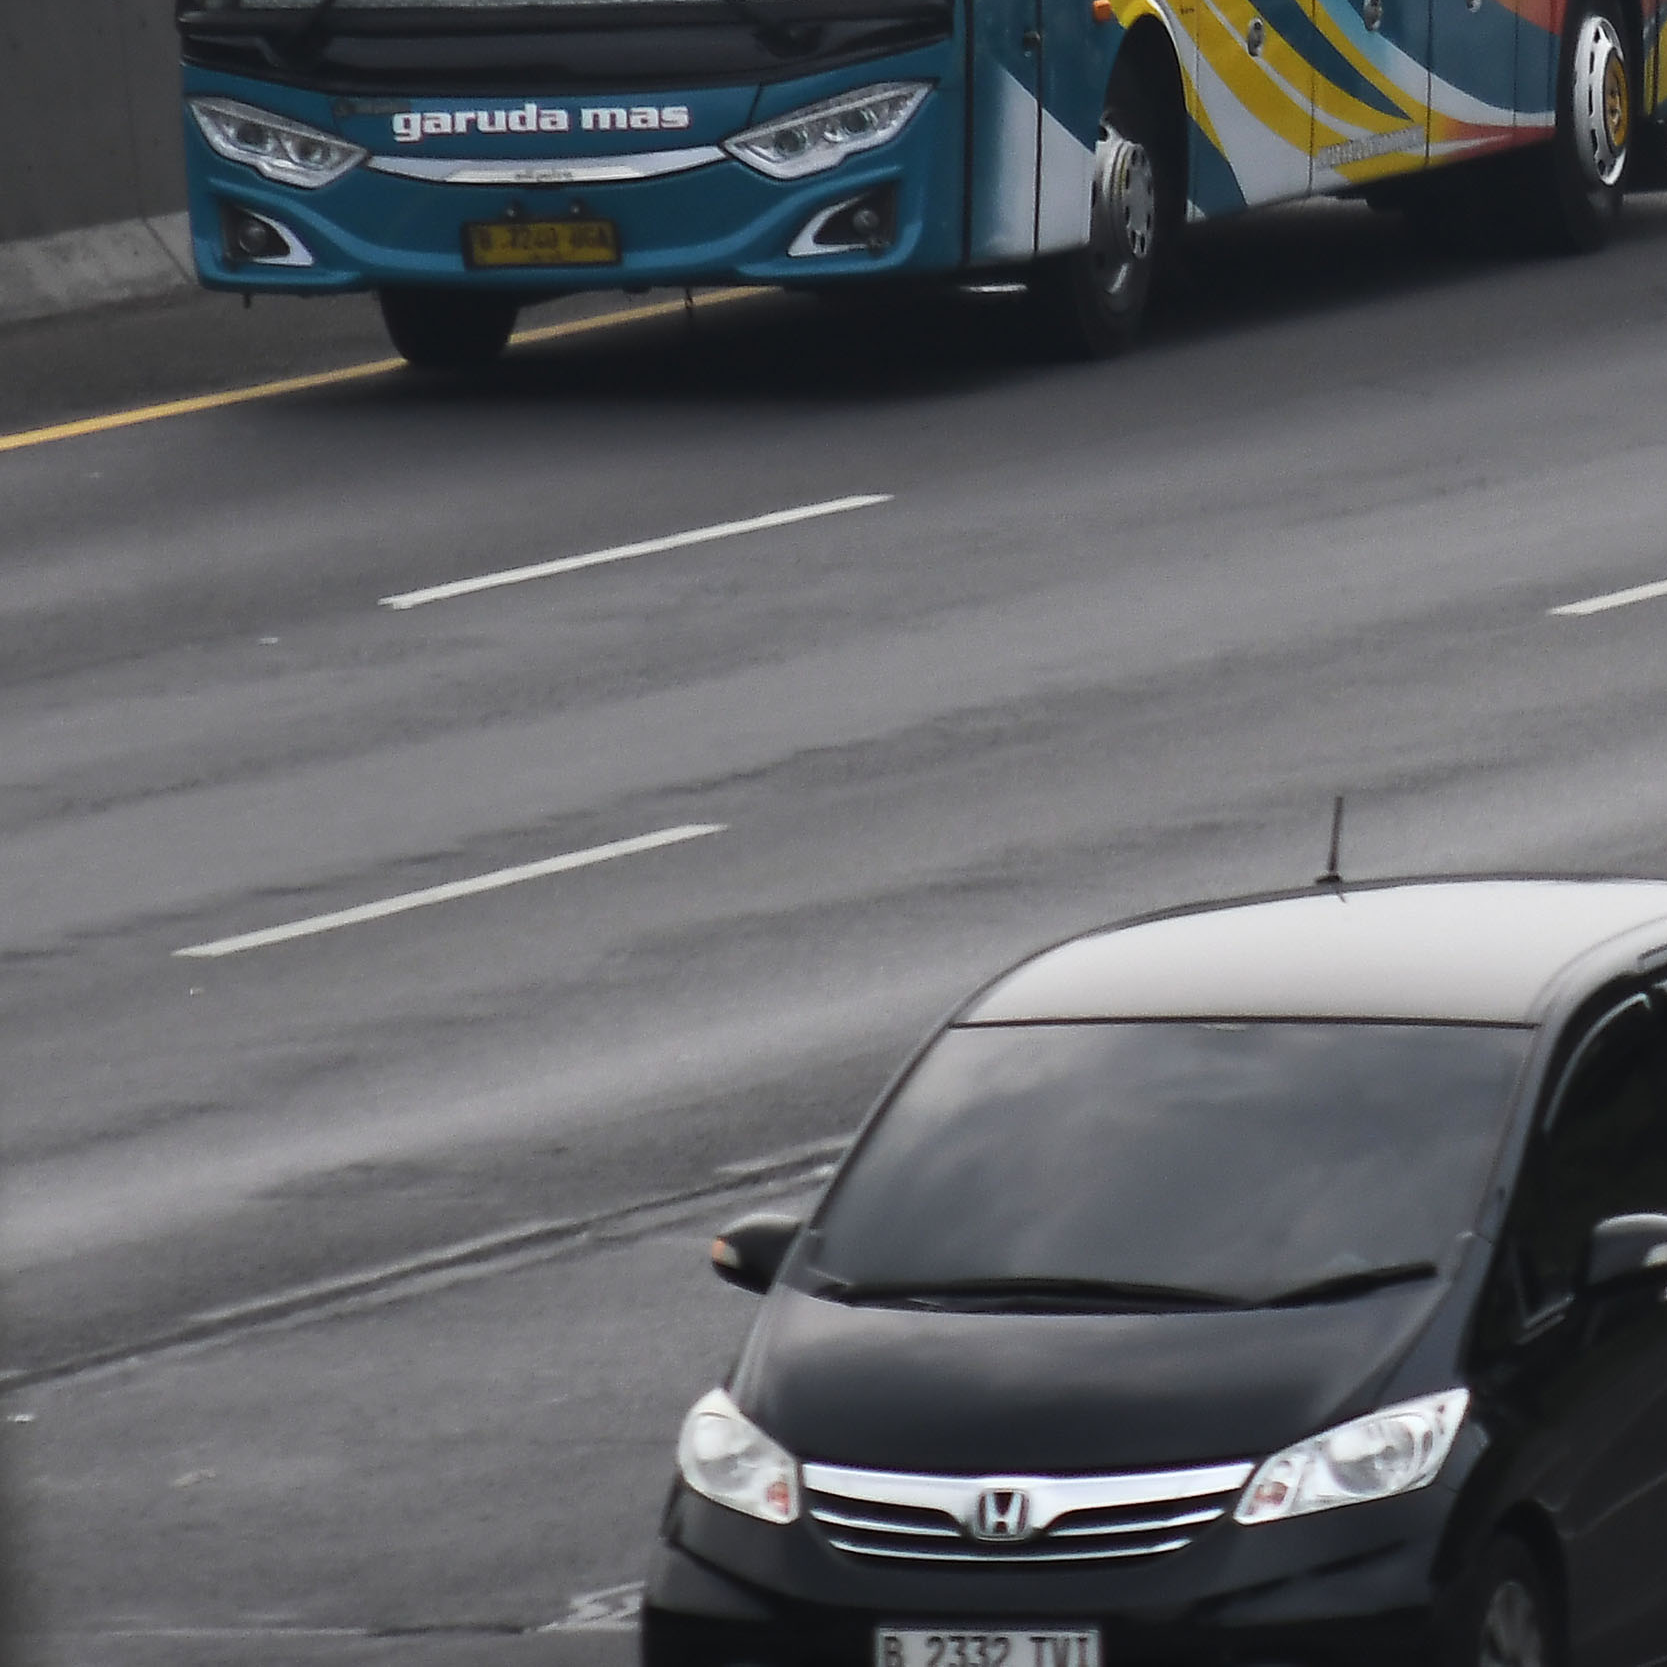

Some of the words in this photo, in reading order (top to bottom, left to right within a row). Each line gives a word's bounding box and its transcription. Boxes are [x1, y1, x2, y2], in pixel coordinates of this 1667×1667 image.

[392, 103, 570, 142] garuda
[580, 105, 690, 131] mas
[884, 1635, 904, 1667] B
[925, 1635, 1010, 1667] 2332
